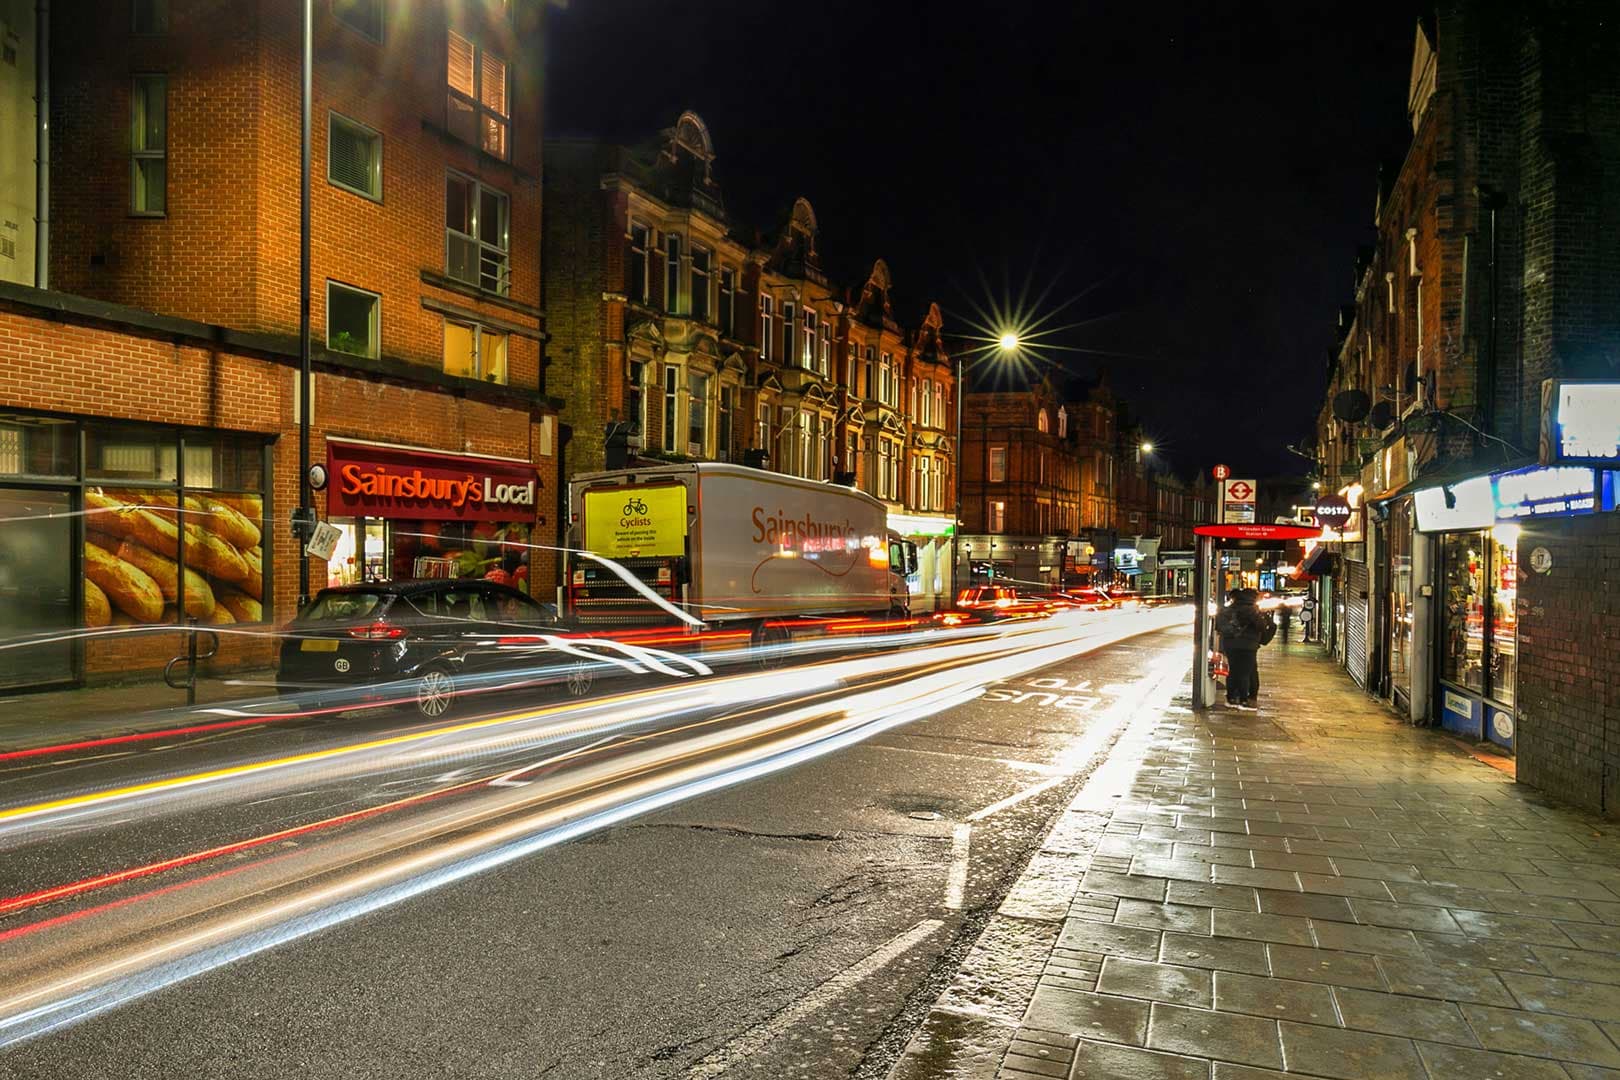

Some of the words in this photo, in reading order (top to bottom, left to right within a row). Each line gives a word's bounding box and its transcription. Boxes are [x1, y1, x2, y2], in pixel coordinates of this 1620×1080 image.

[1217, 466, 1226, 478] B
[341, 464, 482, 507] Sainsbury's
[484, 477, 534, 505] Local
[1317, 506, 1349, 515] COSTA
[620, 516, 651, 528] Cyclists
[752, 506, 856, 550] Sainsbury's
[337, 661, 348, 670] GB
[982, 688, 1101, 710] BUS
